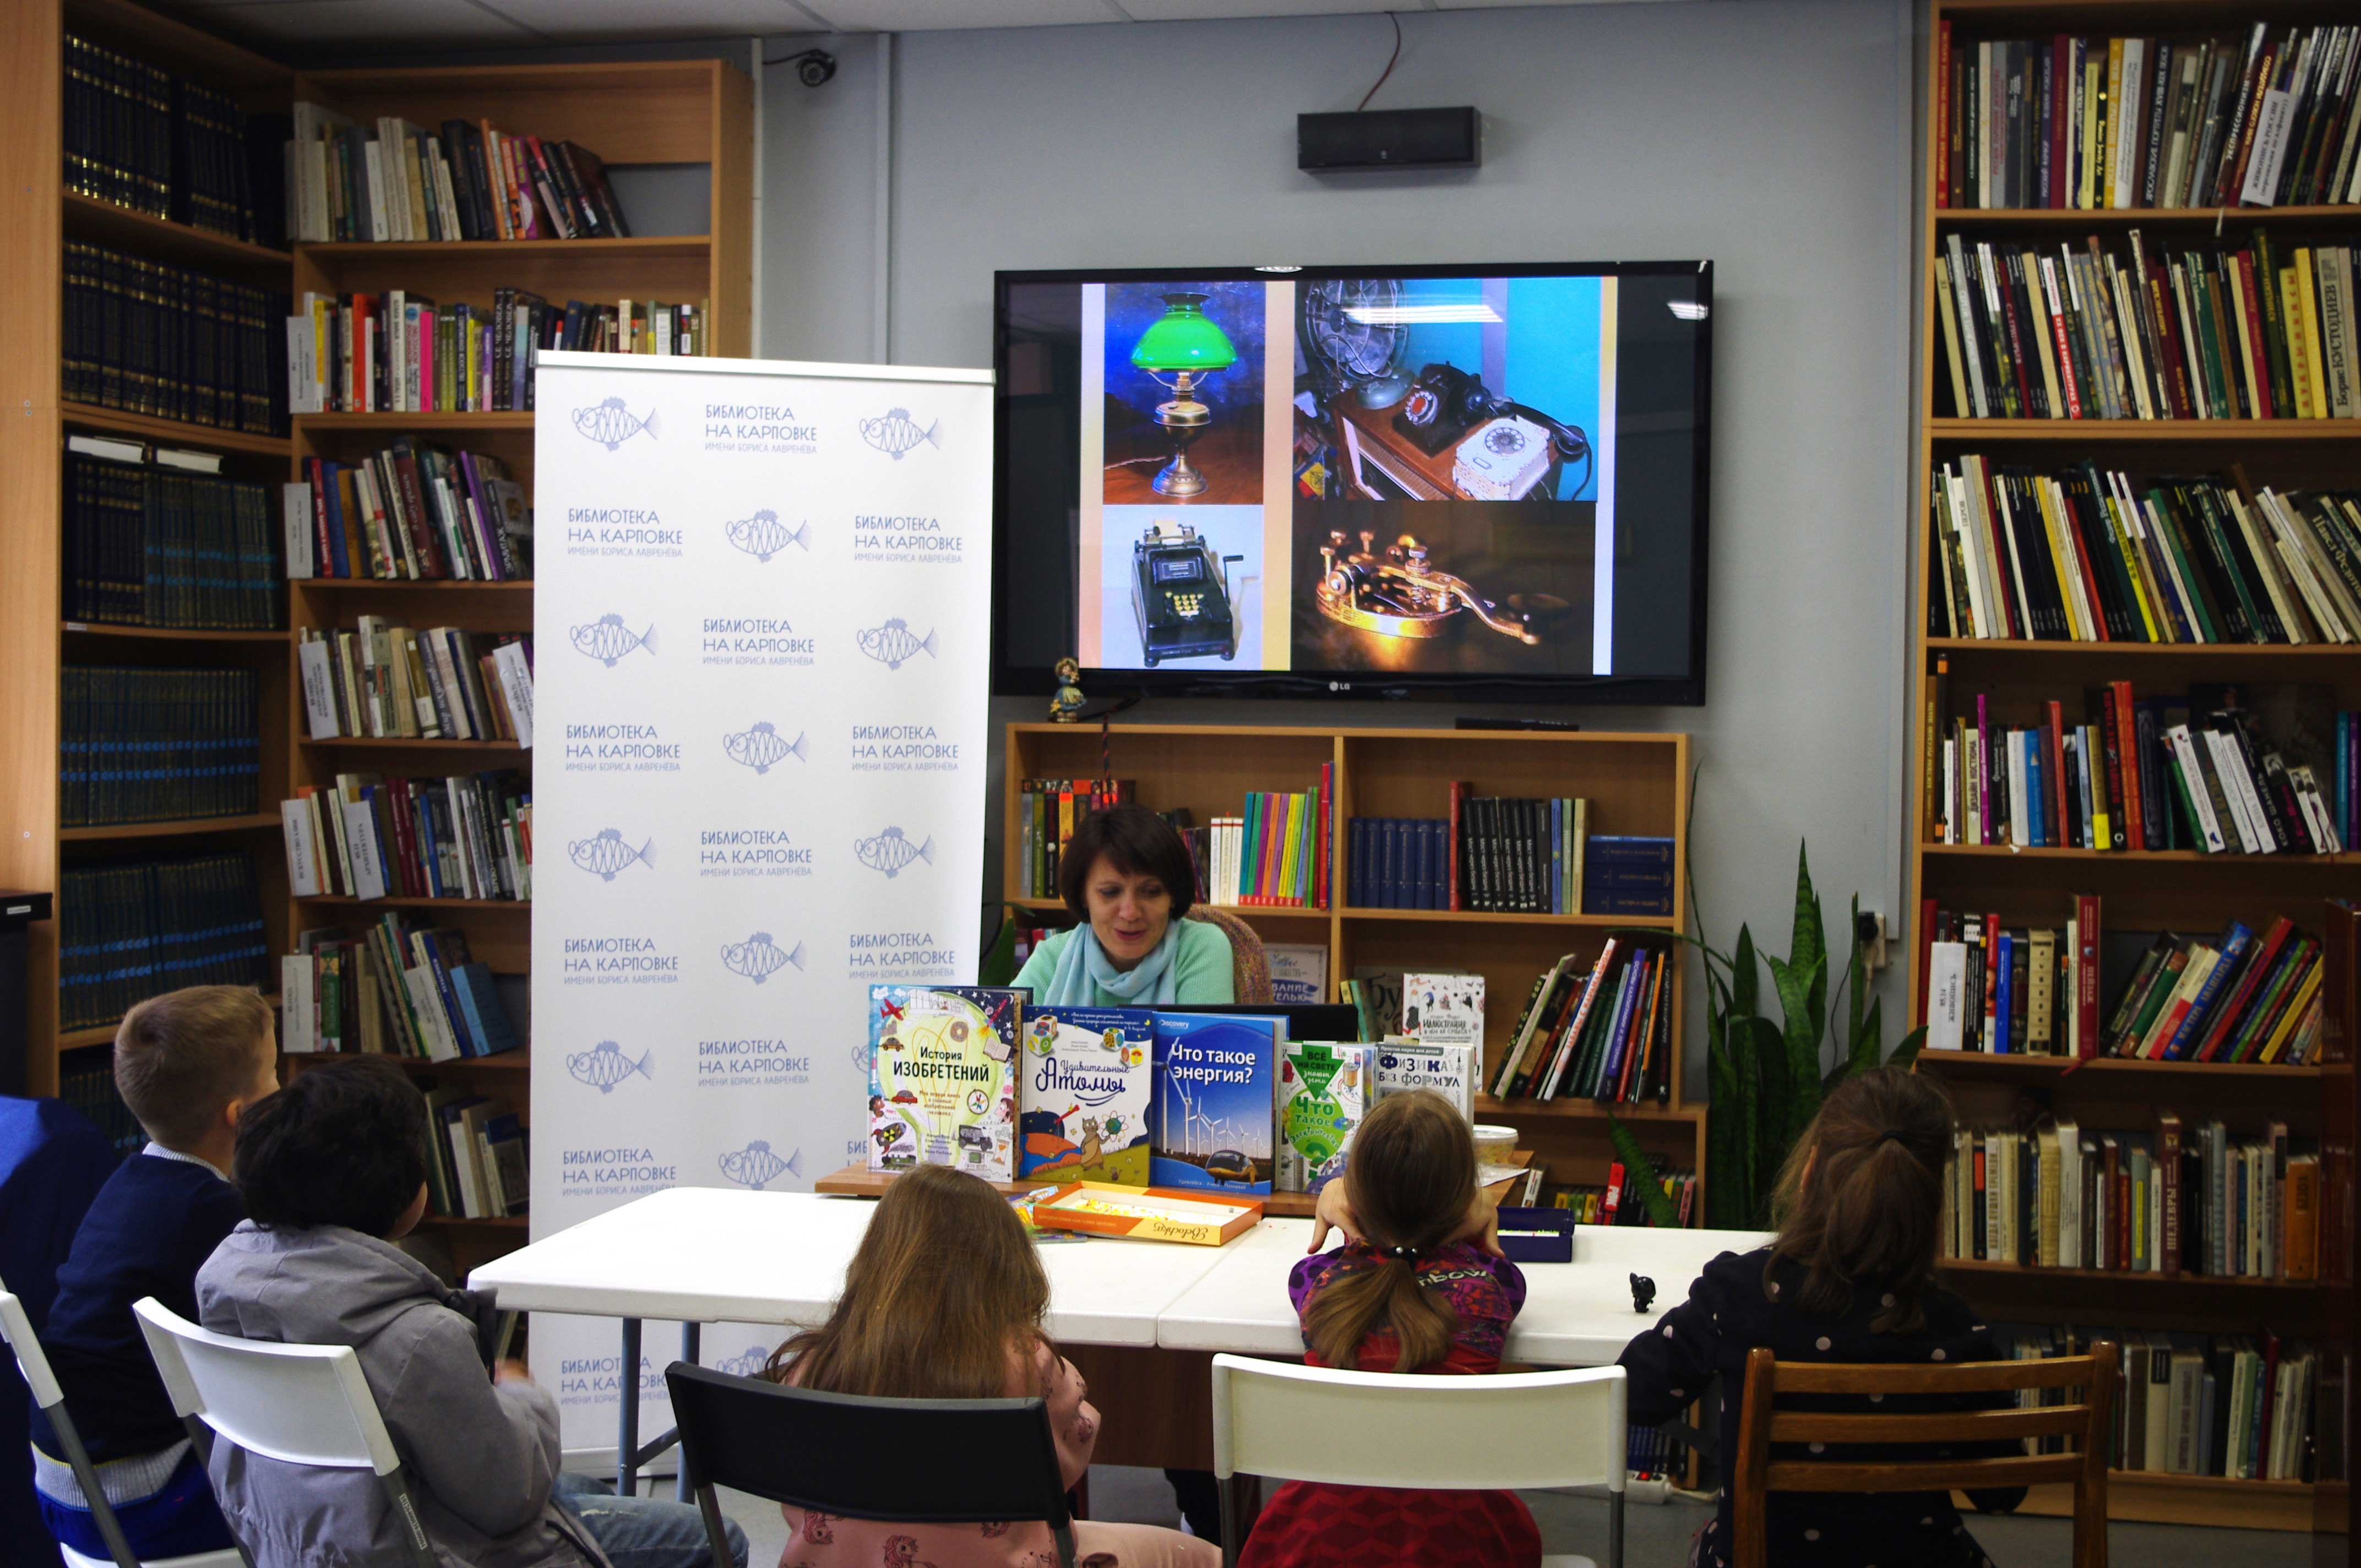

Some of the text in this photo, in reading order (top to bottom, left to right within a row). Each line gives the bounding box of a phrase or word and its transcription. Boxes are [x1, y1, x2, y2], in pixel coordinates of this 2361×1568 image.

[706, 404, 795, 421] БИБЛИОТЕКА
[705, 424, 817, 441] НА КАРПОВКЕ
[705, 443, 735, 451] ИМЕНИ
[738, 443, 769, 452] БОРИСА
[568, 508, 660, 524] БИБЛИОТЕКА
[855, 515, 940, 531] БИБЛИОТЕКА
[568, 527, 682, 545] НА КАРПОВКЕ
[855, 535, 962, 551] НА КАРПОВКЕ
[568, 546, 599, 556] ИМЕНИ
[601, 547, 633, 556] БОРИСА
[855, 553, 883, 561] ИМЕНИ
[886, 553, 916, 563] БОРИСА
[704, 618, 792, 634] БИБЛИОТЕКА
[703, 638, 814, 653] НА КАРПОВКЕ
[703, 656, 732, 665] ИМЕНИ
[735, 656, 766, 665] БОРИСА
[566, 725, 657, 739] БИБЛИОТЕКА
[853, 726, 937, 740] БИБЛИОТЕКА
[566, 744, 680, 759] НА КАРПОВКЕ
[852, 744, 958, 759] НА КАРПОВКЕ
[565, 763, 596, 771] ИМЕНИ
[599, 763, 631, 771] БОРИСА
[852, 763, 881, 771] ИМЕНИ
[883, 762, 912, 771] БОРИСА
[701, 830, 790, 845] БИБЛИОТЕКА
[701, 849, 812, 864] НА КАРПОВКЕ
[700, 868, 730, 876] ИМЕНИ
[733, 868, 763, 876] БОРИСА
[564, 938, 656, 954] БИБЛИОТЕКА
[850, 933, 933, 948] БИБЛИОТЕКА
[564, 956, 678, 972] НА КАРПОВКЕ
[850, 950, 954, 966] НА КАРПОВКЕ
[564, 976, 595, 985] ИМЕНИ
[597, 976, 629, 984] БОРИСА
[850, 971, 878, 979] ИМЕНИ
[880, 969, 910, 979] БОРИСА
[1274, 992, 1306, 1001] ЕЛЬЮ
[699, 1039, 787, 1056] БИБЛИОТЕКА
[921, 1047, 962, 1063] История
[1172, 1044, 1256, 1066] Что такое
[699, 1057, 809, 1074] НА КАРПОВКЕ
[894, 1061, 989, 1082] ИЗОБРЕТЕНИЙ
[1060, 1059, 1130, 1076] Удивительные
[698, 1078, 728, 1087] ИМЕНИ
[730, 1077, 761, 1086] БОРИСА
[1036, 1057, 1126, 1092] Атомы
[1173, 1066, 1253, 1086] энергия?
[1295, 1096, 1334, 1115] Что
[1295, 1114, 1331, 1126] такое
[563, 1148, 654, 1165] БИБЛИОТЕКА
[563, 1166, 676, 1184] НА КАРПОВКЕ
[562, 1188, 593, 1196] ИМЕНИ
[596, 1186, 627, 1195] БОРИСА
[562, 1357, 651, 1374] БИБЛИОТА
[562, 1378, 588, 1392] НА
[561, 1396, 591, 1404] ИМЕНИ
[594, 1393, 620, 1403] БОРИС
